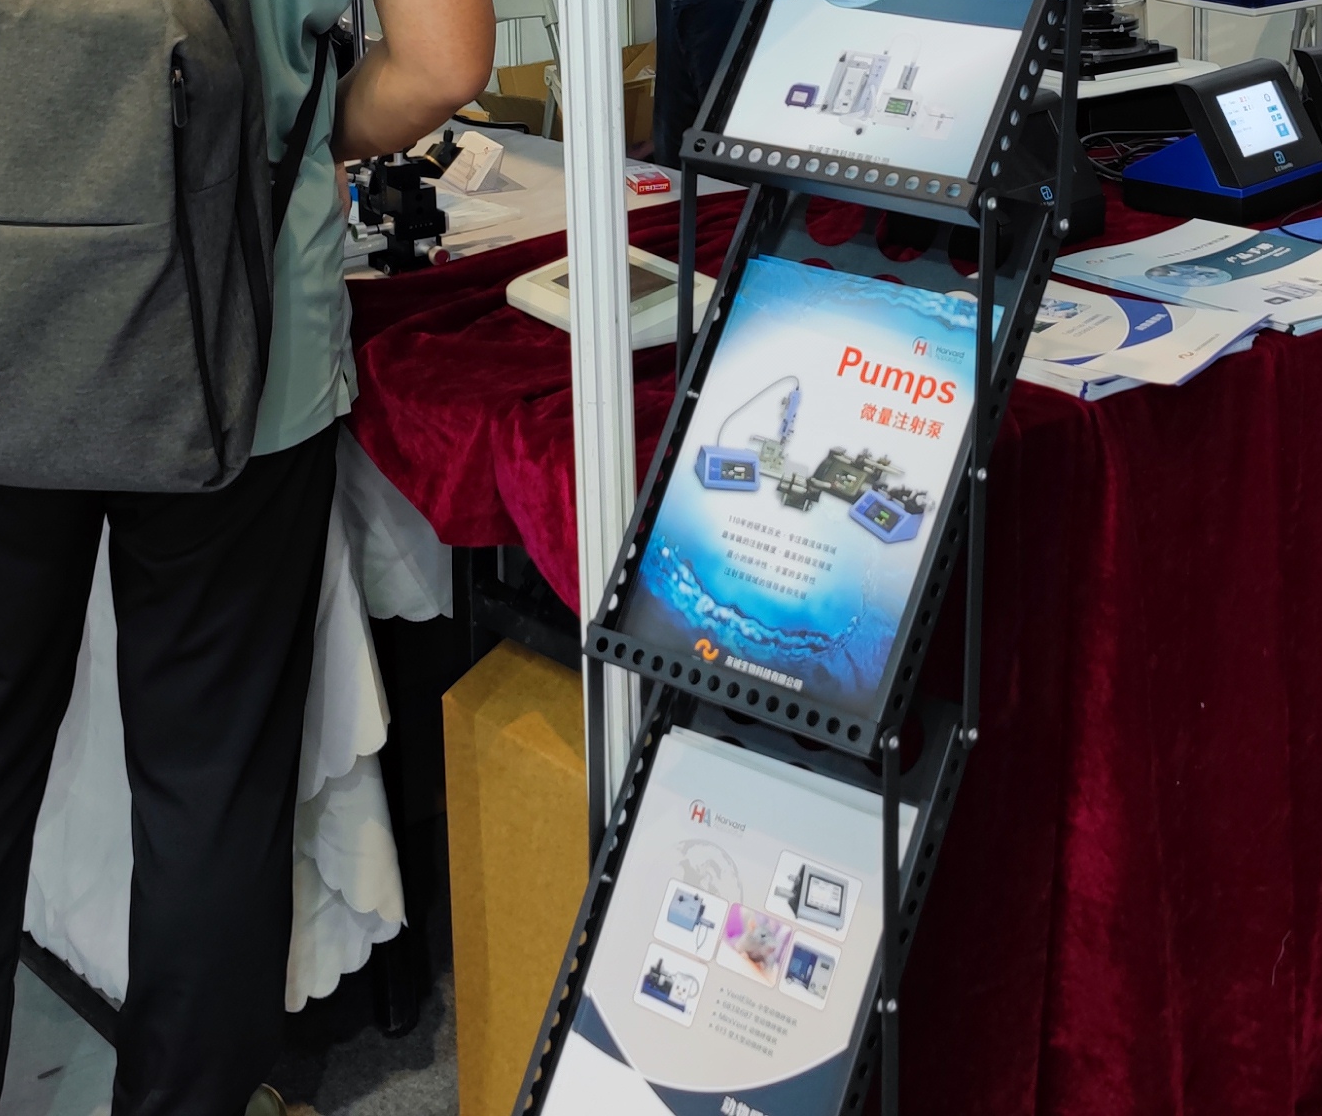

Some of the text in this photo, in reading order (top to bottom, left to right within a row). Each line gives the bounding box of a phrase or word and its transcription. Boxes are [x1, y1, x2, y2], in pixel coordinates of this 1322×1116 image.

[936, 346, 965, 359] Harvard
[837, 346, 957, 405] Pumps
[860, 402, 945, 440] 微量注射泵
[714, 813, 747, 832] Harvard
